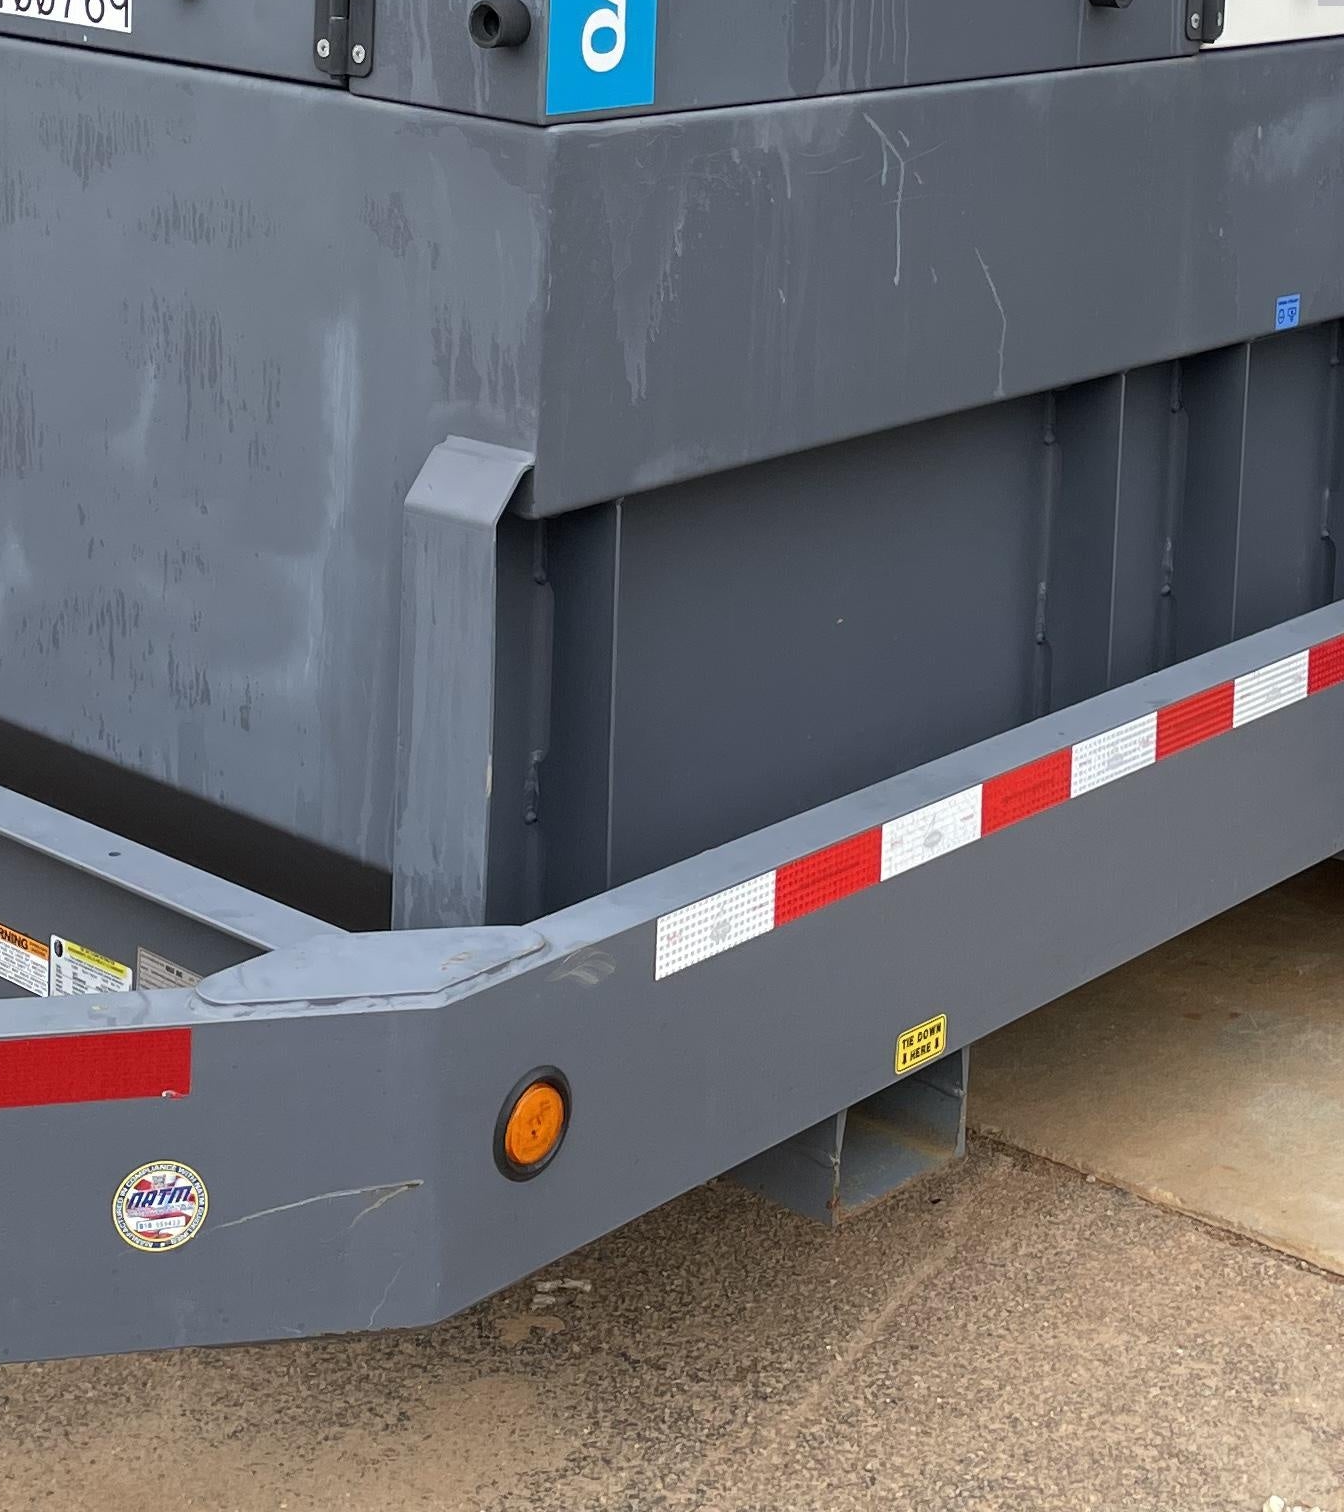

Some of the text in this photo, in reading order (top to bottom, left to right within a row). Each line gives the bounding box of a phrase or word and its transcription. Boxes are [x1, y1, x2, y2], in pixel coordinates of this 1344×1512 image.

[902, 1022, 942, 1049] TIE DOWN
[910, 1042, 932, 1061] HERE
